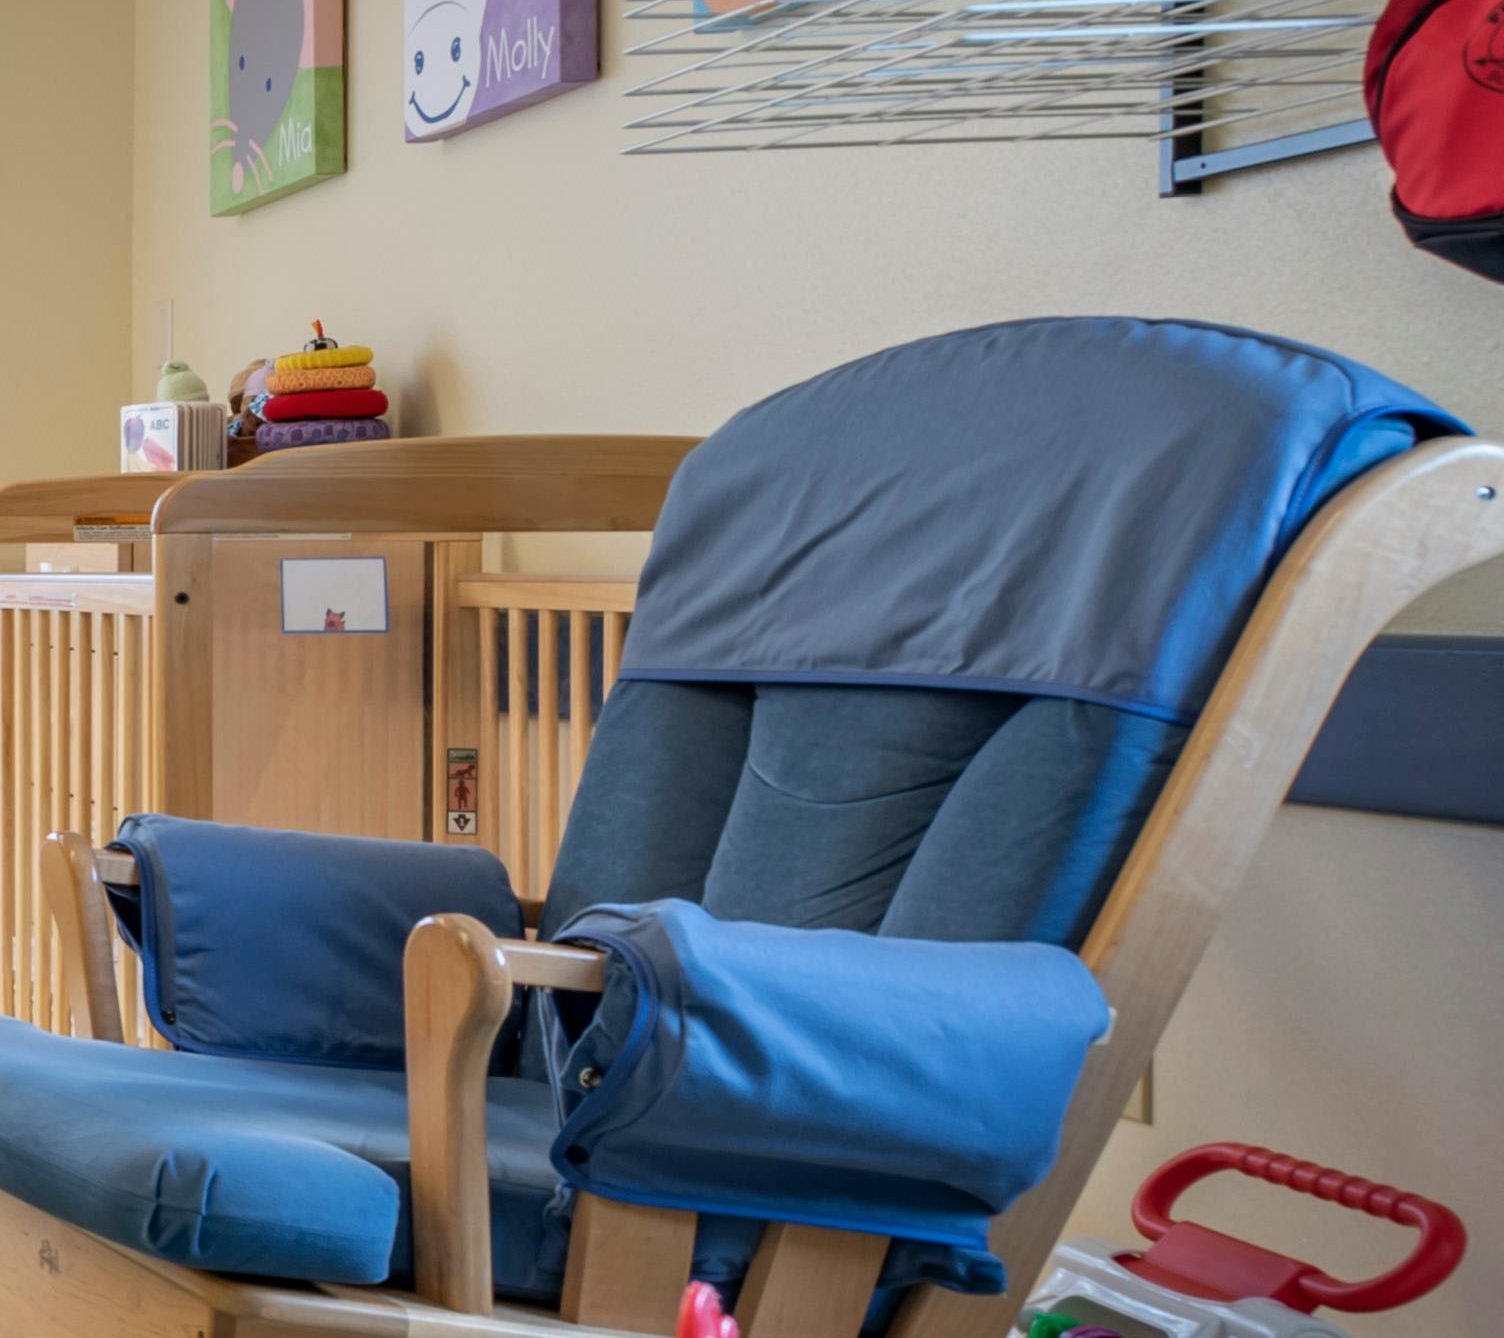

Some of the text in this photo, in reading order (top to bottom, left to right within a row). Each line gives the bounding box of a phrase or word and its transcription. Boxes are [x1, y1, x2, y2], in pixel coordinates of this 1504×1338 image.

[486, 16, 554, 89] Molly
[279, 117, 313, 167] Mia
[149, 418, 170, 430] ABC
